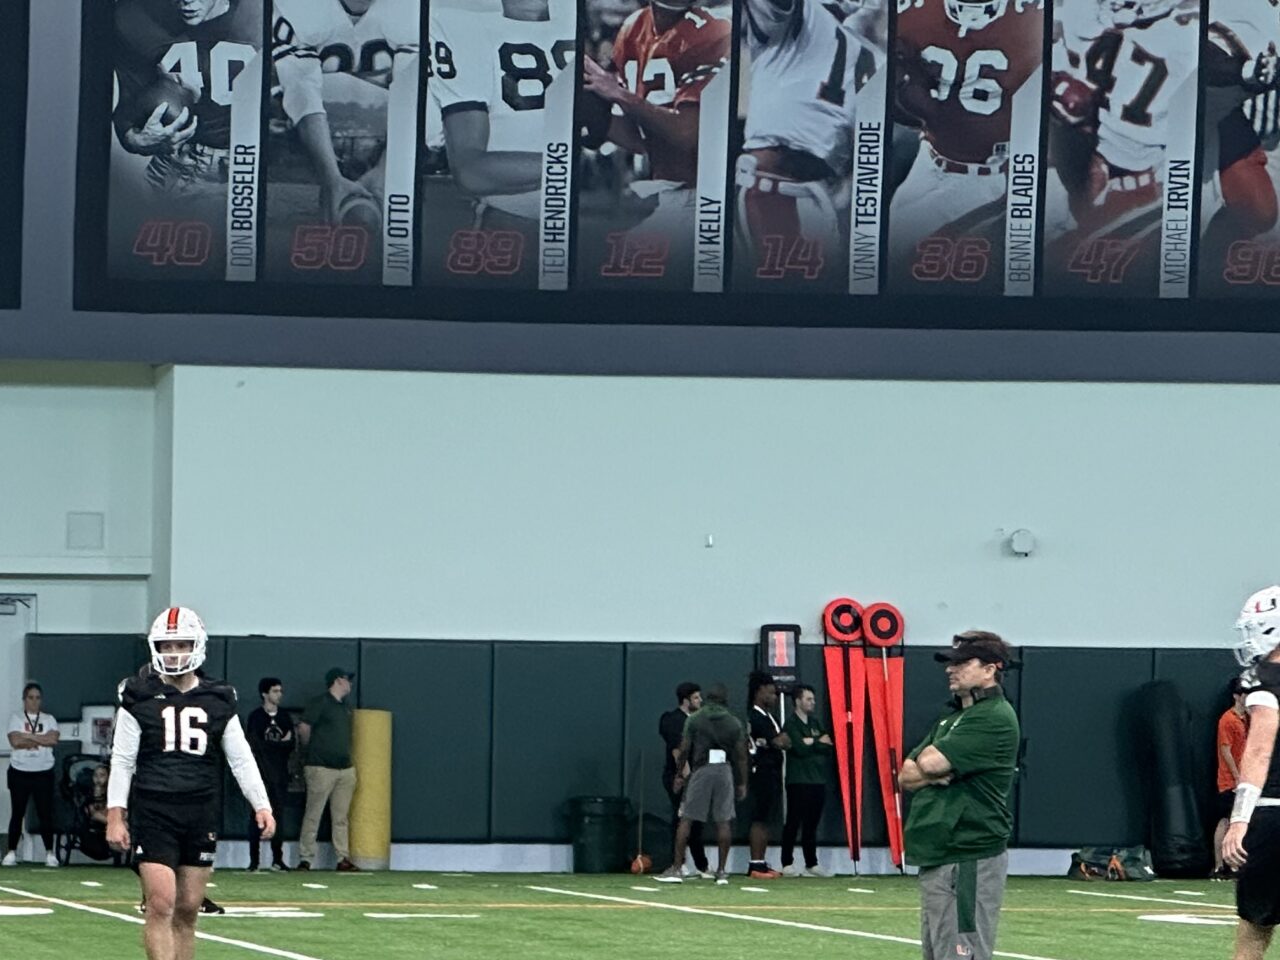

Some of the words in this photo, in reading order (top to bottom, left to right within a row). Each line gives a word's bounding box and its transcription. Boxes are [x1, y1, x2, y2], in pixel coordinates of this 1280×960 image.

[231, 144, 257, 231] BOSSELER
[544, 142, 569, 243] HENDRICKS
[854, 122, 881, 228] TESTAVERDE
[1011, 154, 1035, 219] BLADES
[1167, 160, 1191, 211] IRVIN
[387, 194, 410, 238] OTTO
[699, 196, 722, 245] KELLY
[133, 221, 212, 266] 40
[230, 234, 254, 267] DON
[290, 225, 369, 270] 50
[386, 243, 410, 272] JIM
[447, 231, 524, 274] 89
[542, 247, 566, 275] TED
[601, 232, 671, 277] 12
[698, 250, 721, 278] JIM
[756, 234, 825, 279] 14
[853, 231, 877, 281] VINNY
[912, 236, 991, 281] 36
[1007, 223, 1033, 282] BENNIE
[1067, 239, 1140, 283] 47
[1163, 215, 1189, 284] MICHAEL
[161, 706, 208, 756] 16
